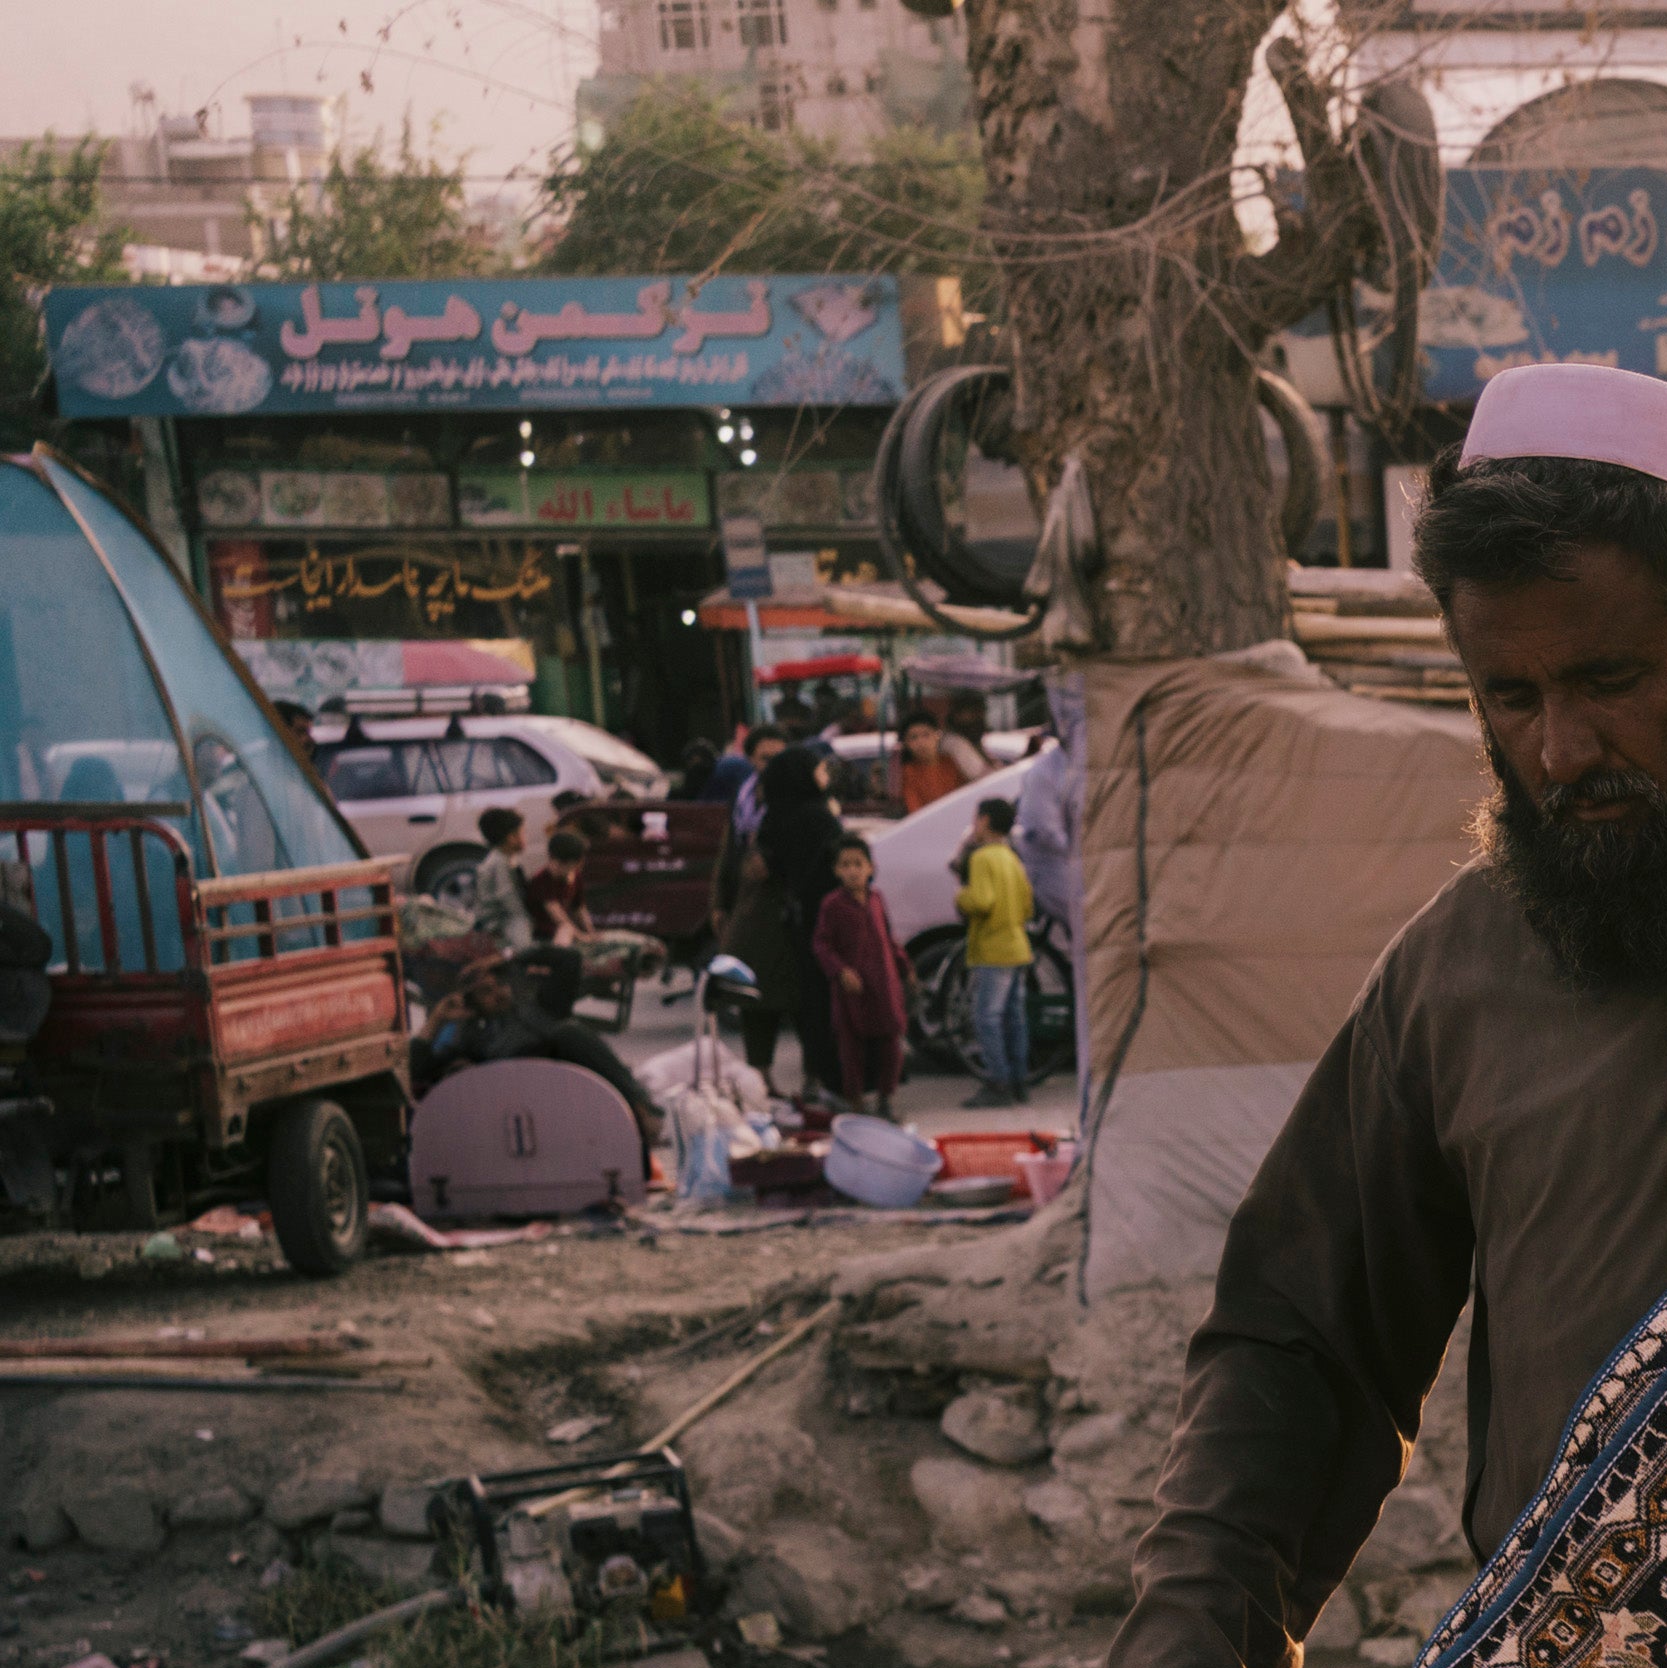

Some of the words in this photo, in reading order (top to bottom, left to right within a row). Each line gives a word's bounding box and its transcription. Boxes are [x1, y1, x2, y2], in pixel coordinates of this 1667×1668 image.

[1489, 189, 1571, 270] زم
[1579, 188, 1657, 267] زم
[280, 284, 481, 360] هوتل
[491, 279, 773, 356] ترکمن
[537, 480, 593, 521] الله
[606, 485, 694, 522] ماشاء
